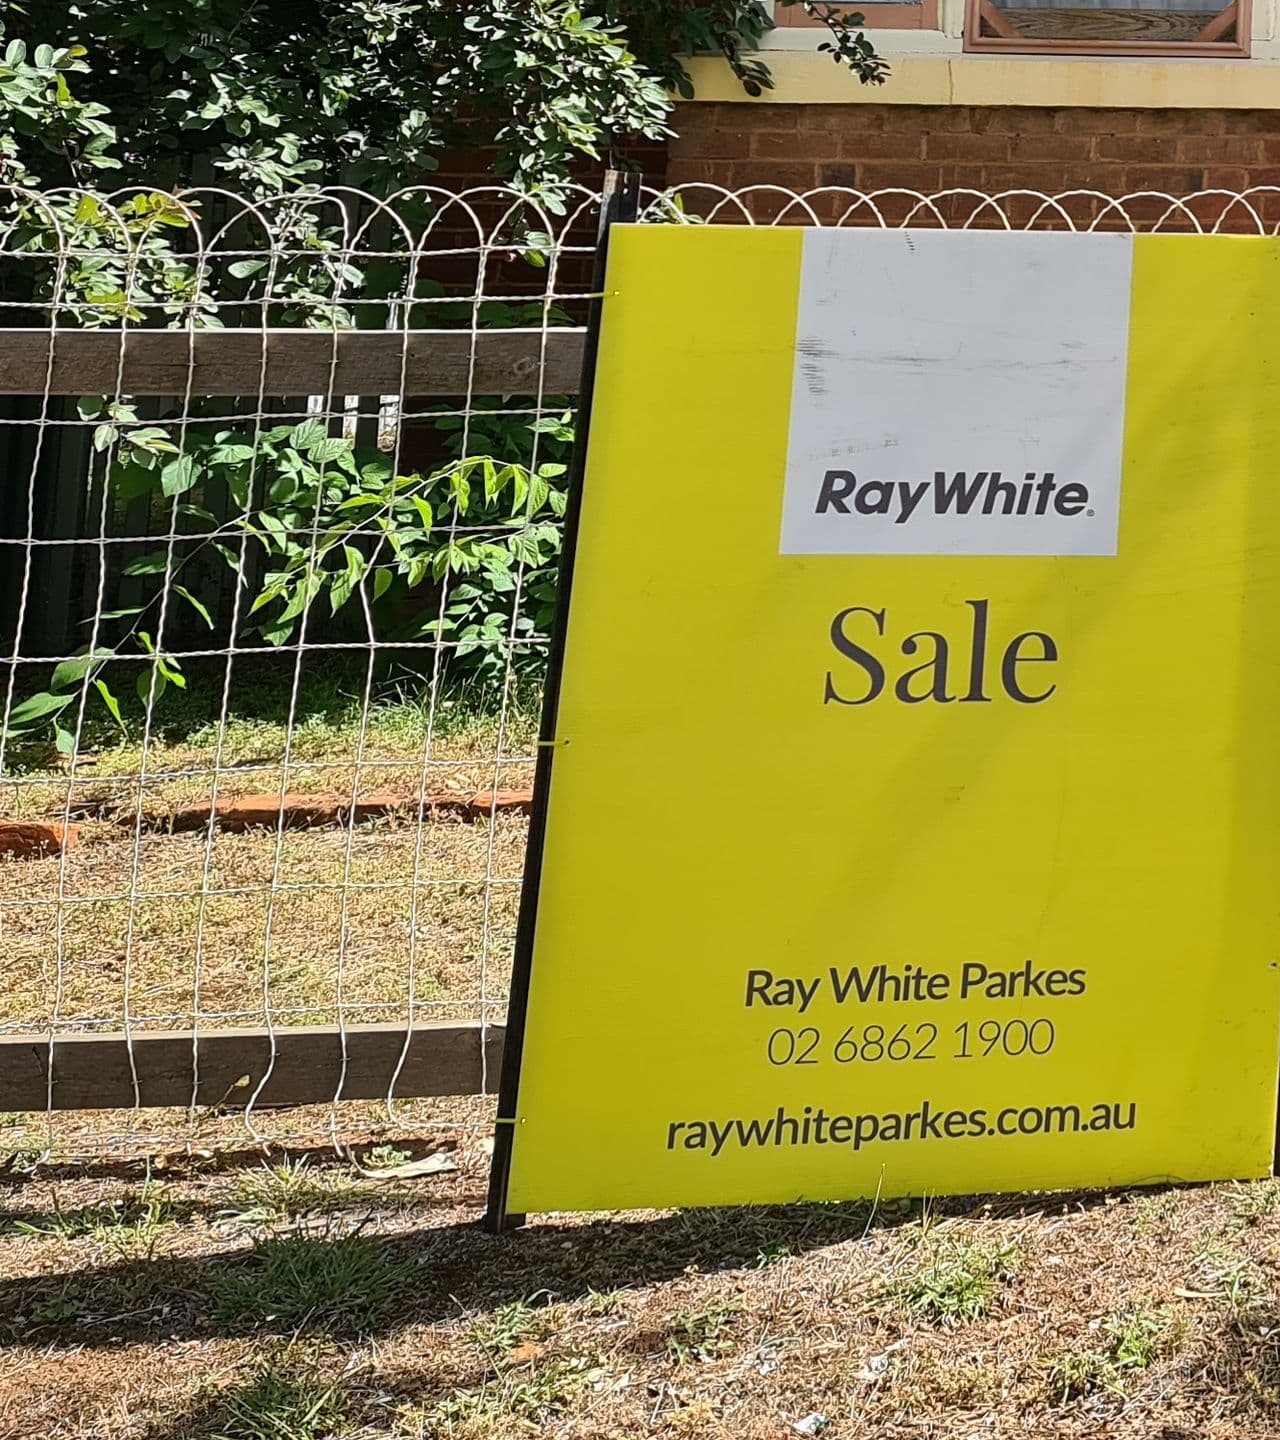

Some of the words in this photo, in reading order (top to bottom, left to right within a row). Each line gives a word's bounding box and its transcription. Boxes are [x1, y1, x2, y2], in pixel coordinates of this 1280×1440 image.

[823, 598, 1058, 705] Sale
[745, 969, 822, 1014] Ray
[829, 964, 951, 1004] White
[960, 959, 1087, 999] Parkes
[767, 1027, 820, 1066] 02
[833, 1022, 938, 1063] 6862
[953, 1018, 1055, 1058] 1900
[666, 1100, 1136, 1157] raywhiteparkes.com.au
